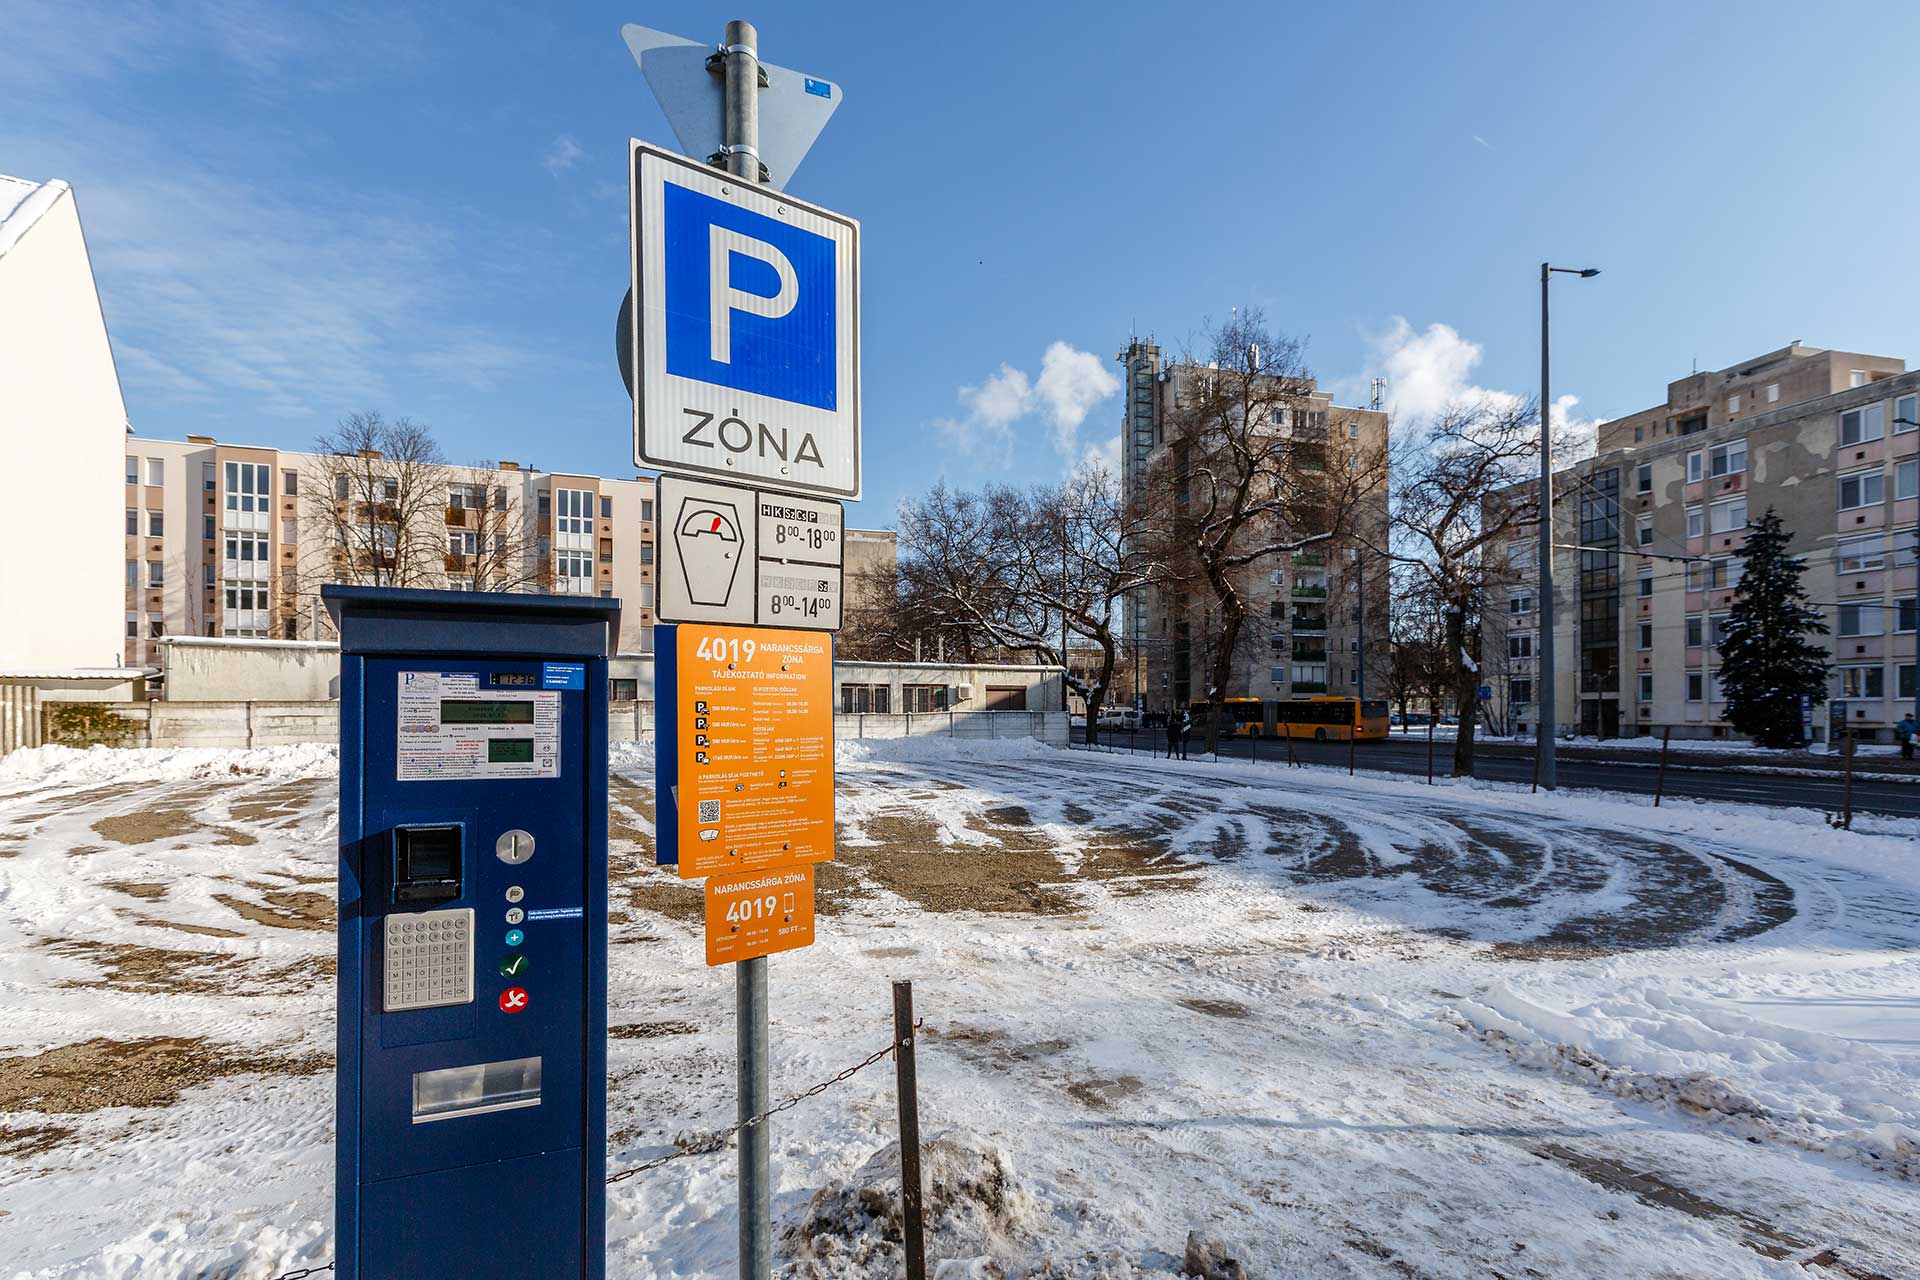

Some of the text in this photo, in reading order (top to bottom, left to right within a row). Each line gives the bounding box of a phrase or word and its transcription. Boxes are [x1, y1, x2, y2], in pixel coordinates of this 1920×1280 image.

[709, 223, 799, 365] P
[682, 407, 824, 468] ZÓNA
[696, 637, 824, 663] 4019 NARANCSSÁRGA
[782, 654, 804, 664] ZÓNA
[712, 669, 764, 680] TÁJÉKOZTATÓ
[714, 873, 806, 895] NARANCSSÁRGA ZÓNA
[726, 895, 777, 922] 4019
